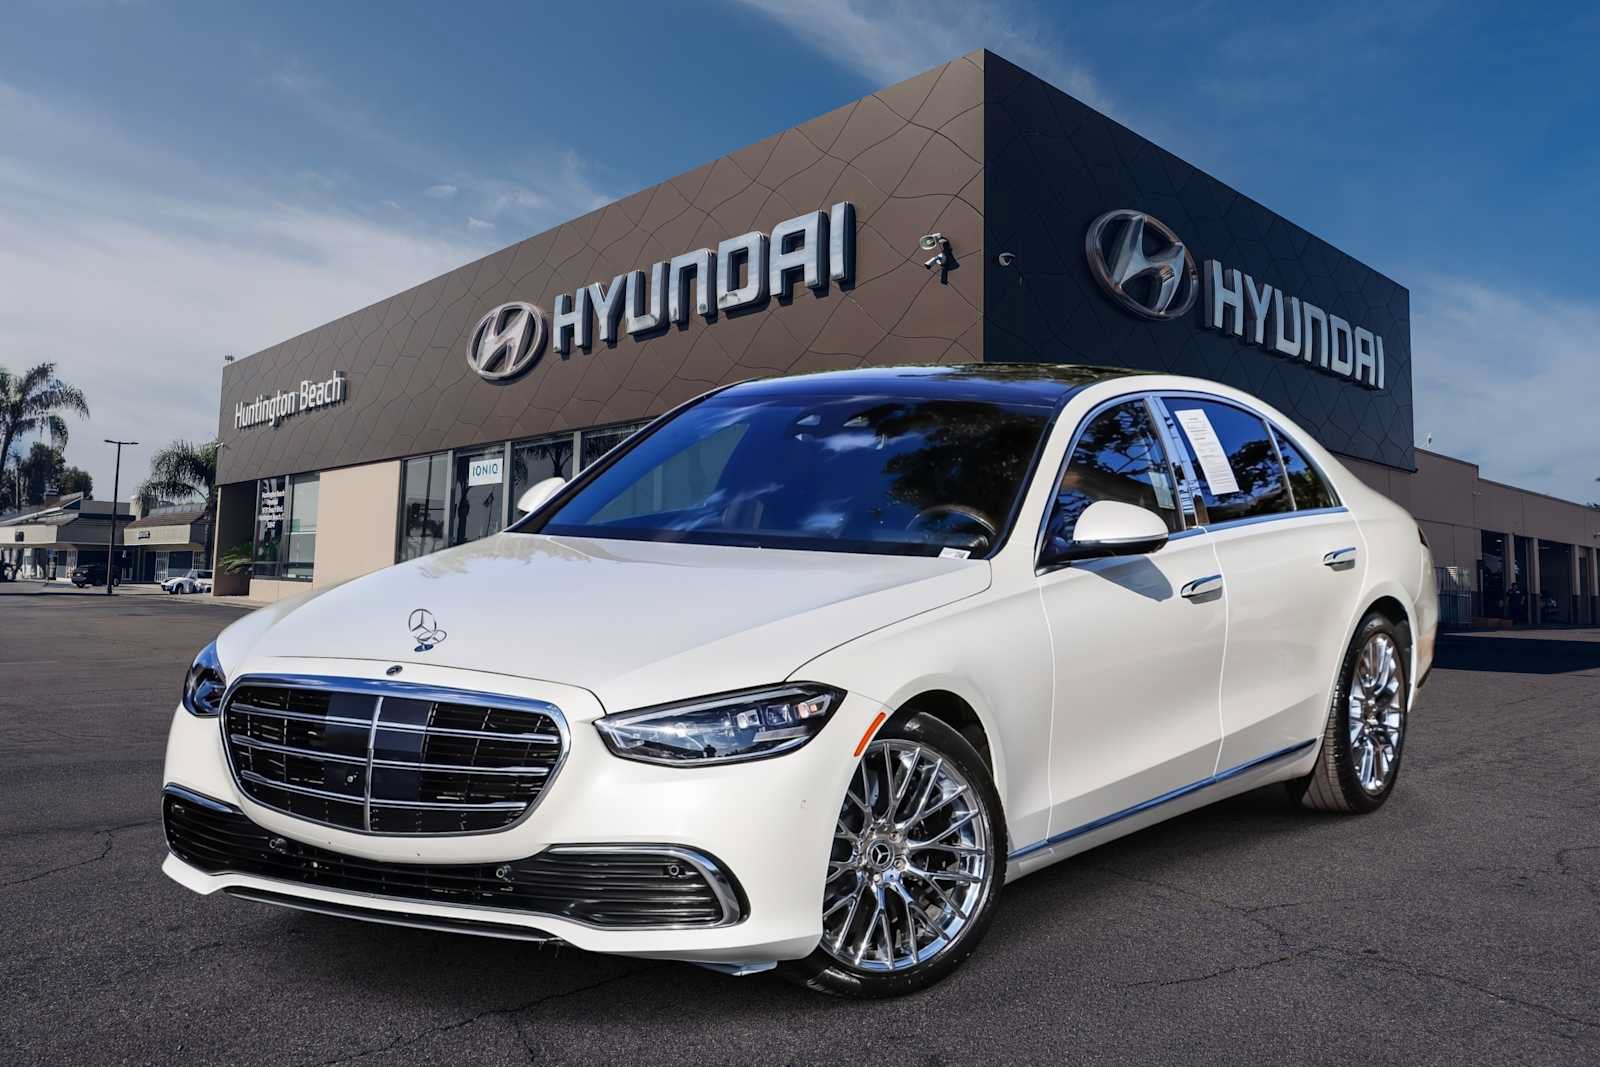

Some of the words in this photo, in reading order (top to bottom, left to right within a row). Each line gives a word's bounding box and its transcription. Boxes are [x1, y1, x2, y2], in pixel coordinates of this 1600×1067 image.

[553, 201, 853, 354] HYUNDAI
[1206, 259, 1385, 390] HYUNDAI
[234, 390, 298, 429] Huntington
[300, 369, 343, 411] Beach
[472, 463, 499, 477] IONIQ
